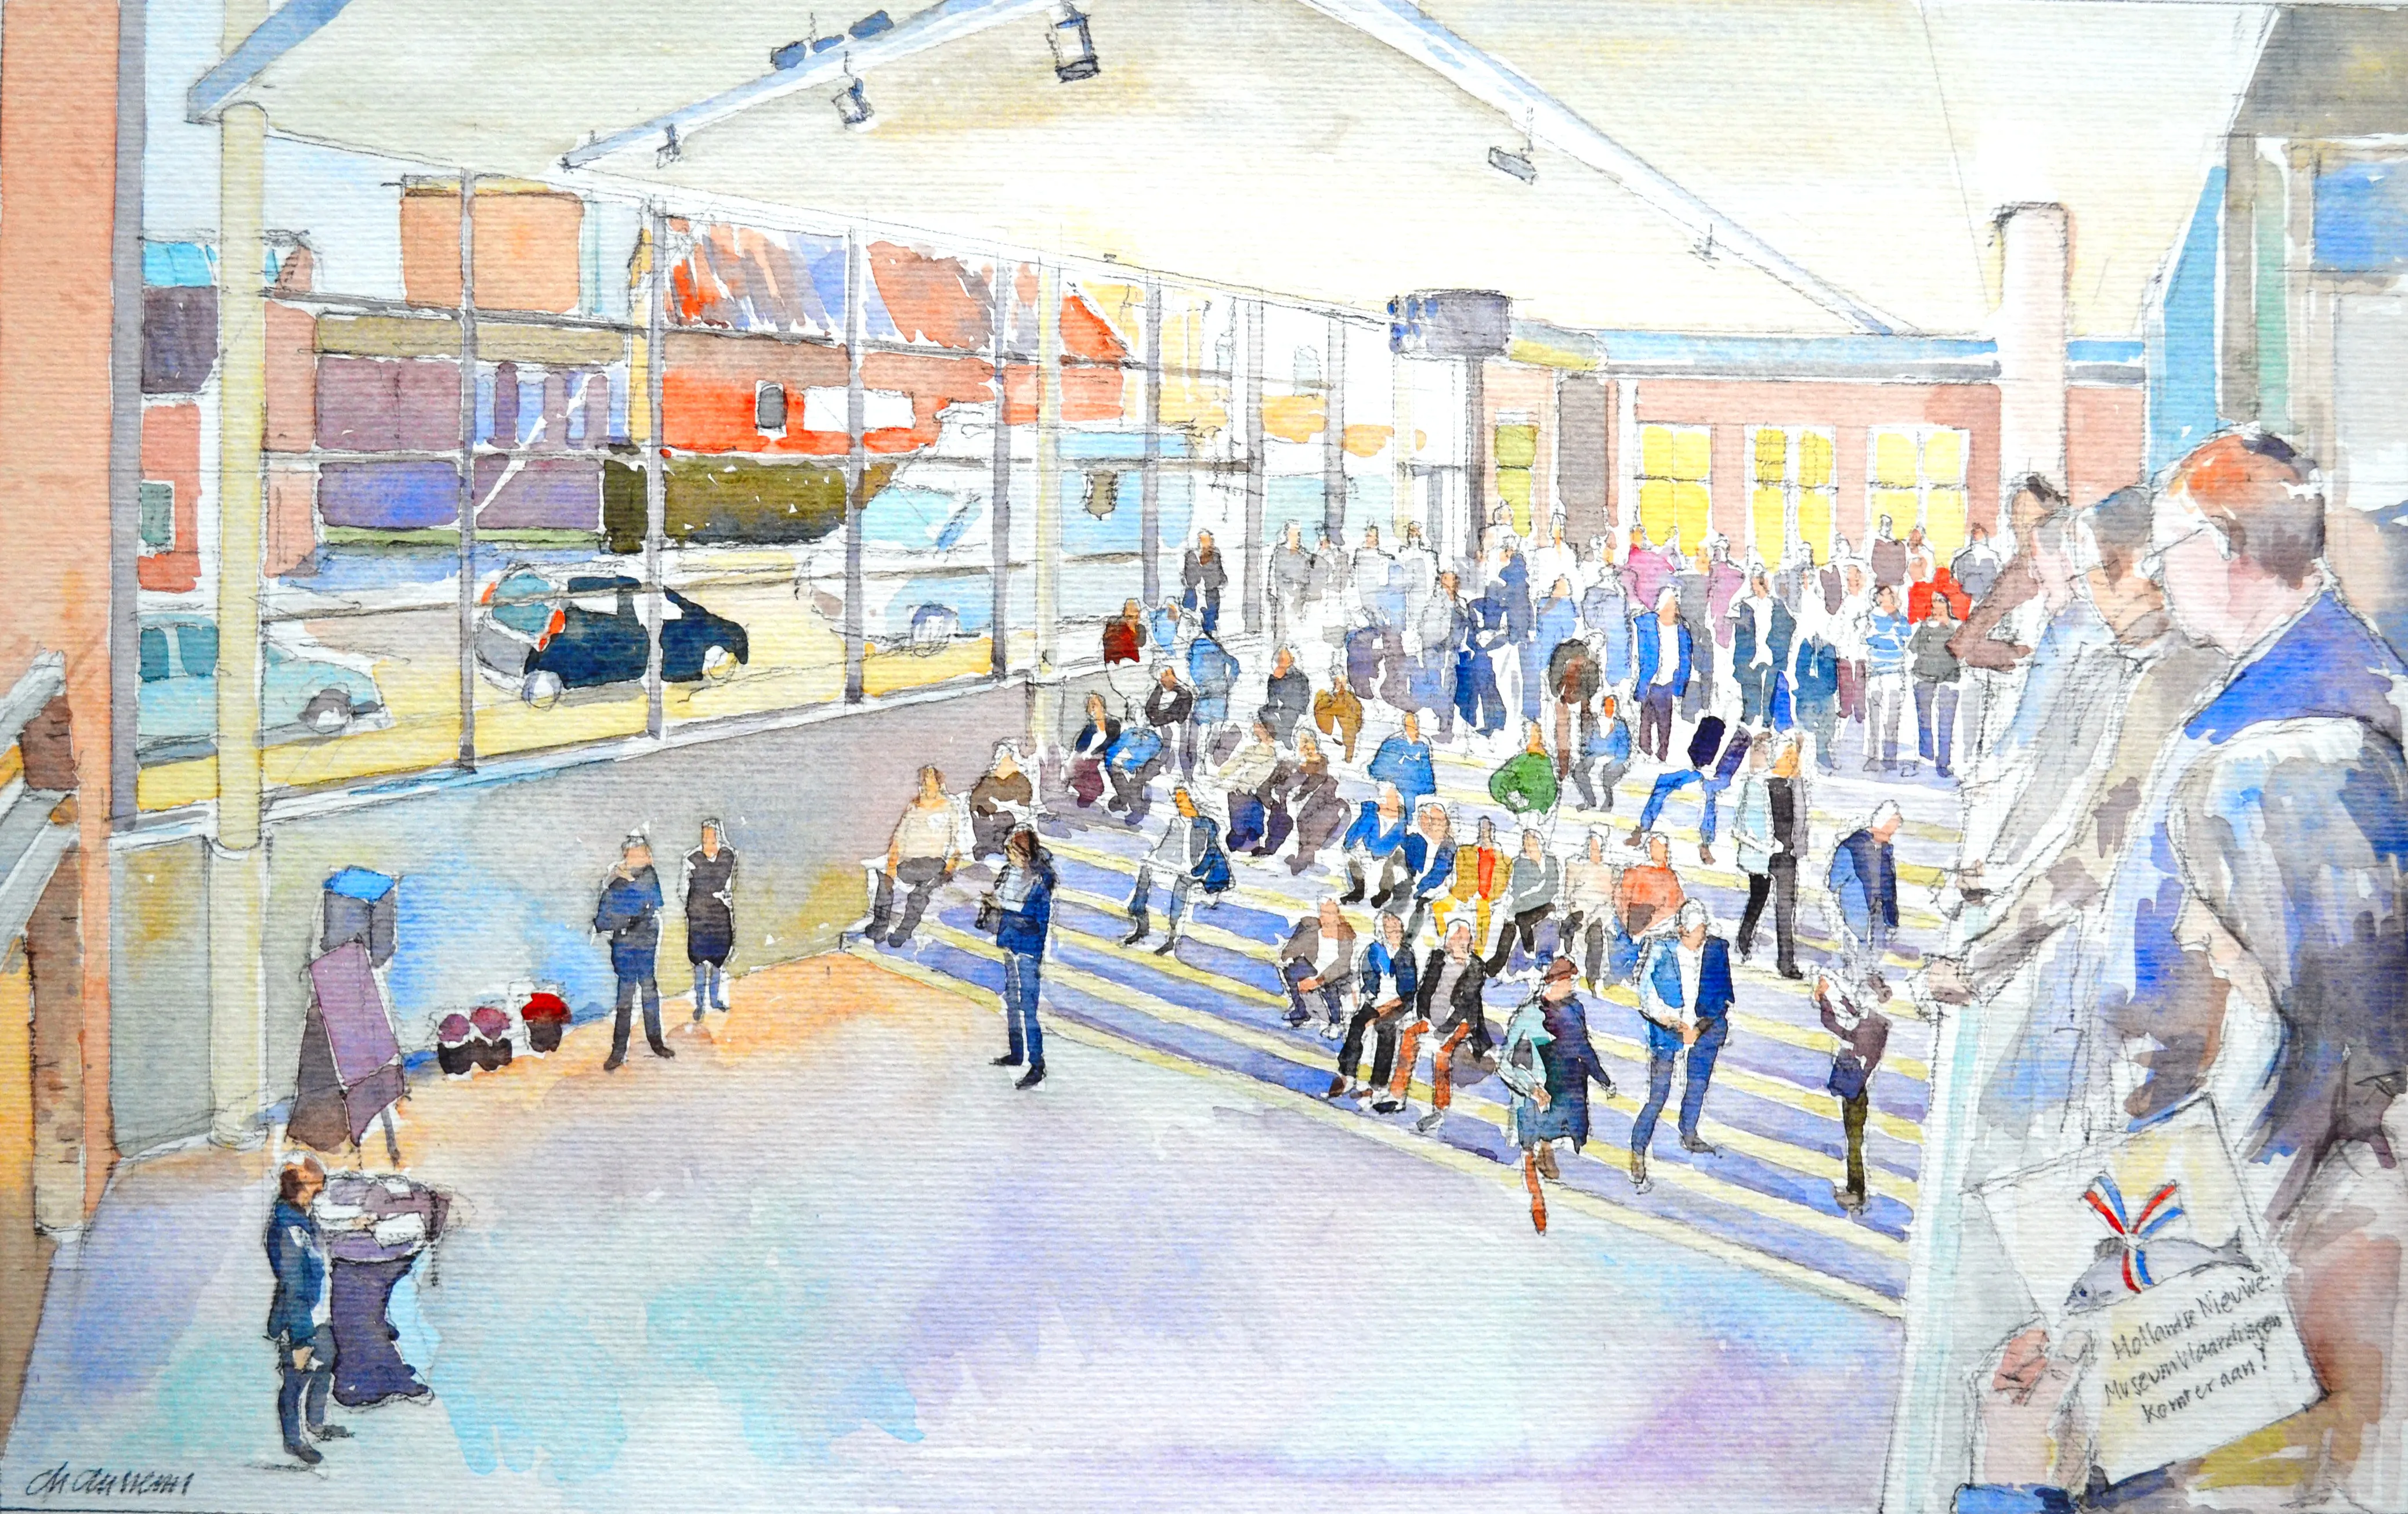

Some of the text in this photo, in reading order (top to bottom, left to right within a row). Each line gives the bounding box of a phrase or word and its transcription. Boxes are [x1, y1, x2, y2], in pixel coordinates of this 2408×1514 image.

[2111, 1309, 2197, 1360] Hollandse
[2105, 1315, 2283, 1406] Museum Vlaardingen
[2195, 1378, 2214, 1400] er
